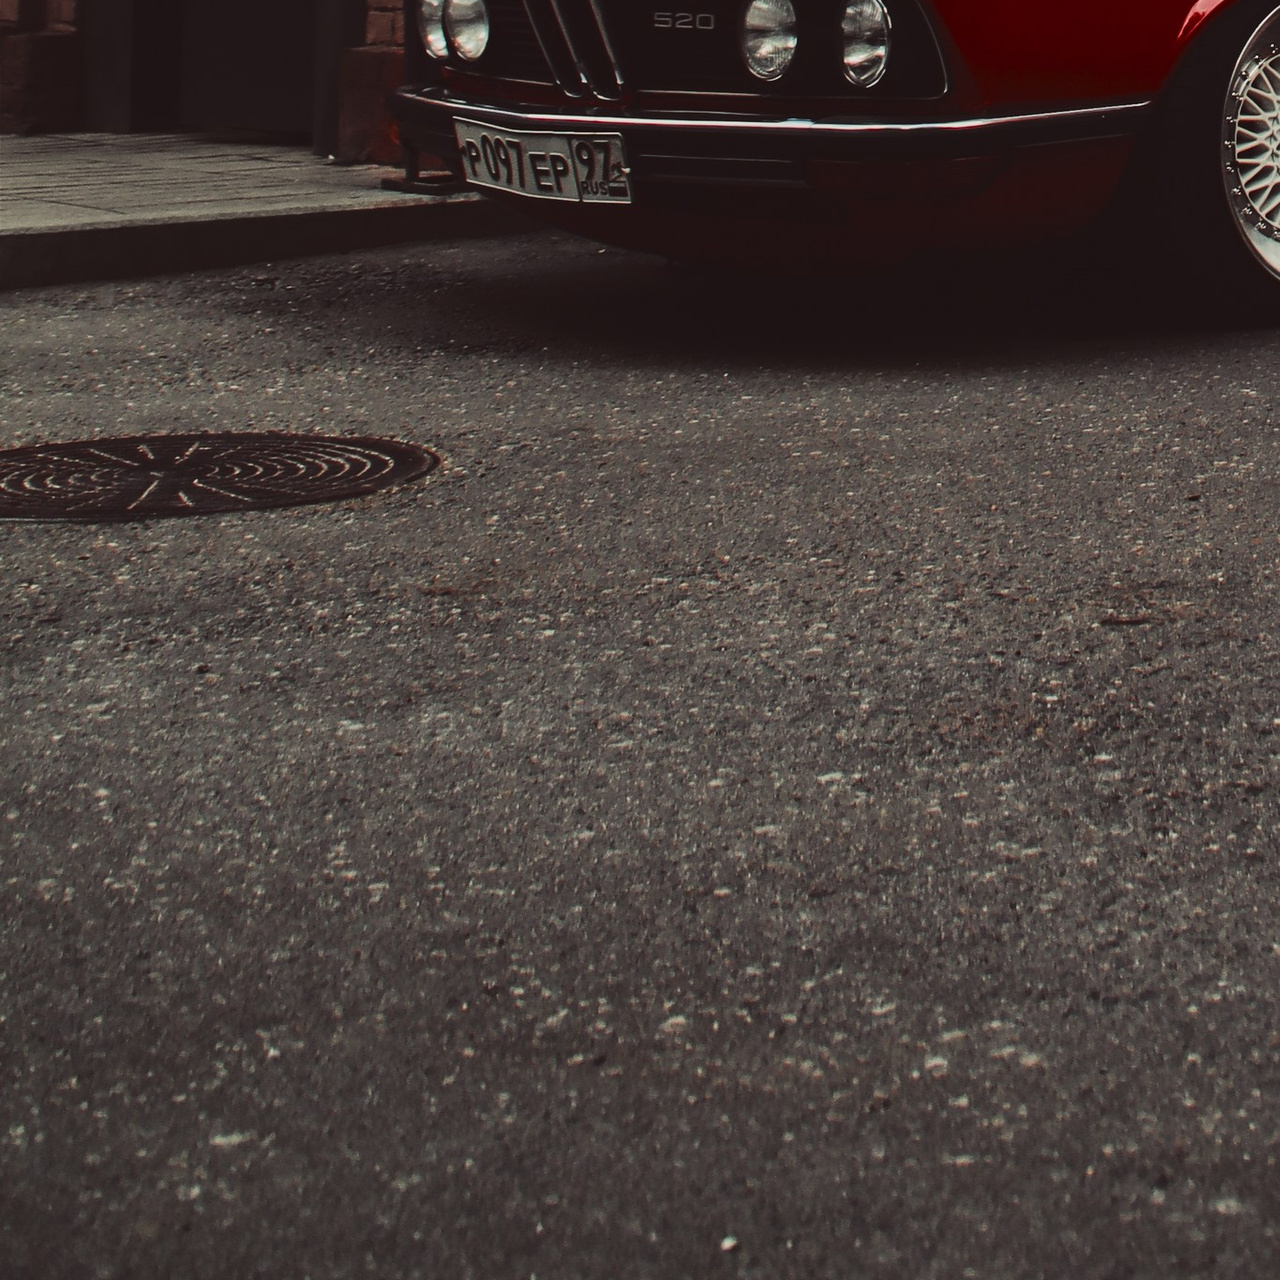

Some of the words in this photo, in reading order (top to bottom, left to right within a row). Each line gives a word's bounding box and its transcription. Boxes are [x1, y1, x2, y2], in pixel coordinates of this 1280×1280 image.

[654, 12, 714, 30] 520
[574, 140, 611, 182] 97
[580, 180, 609, 196] RUS
